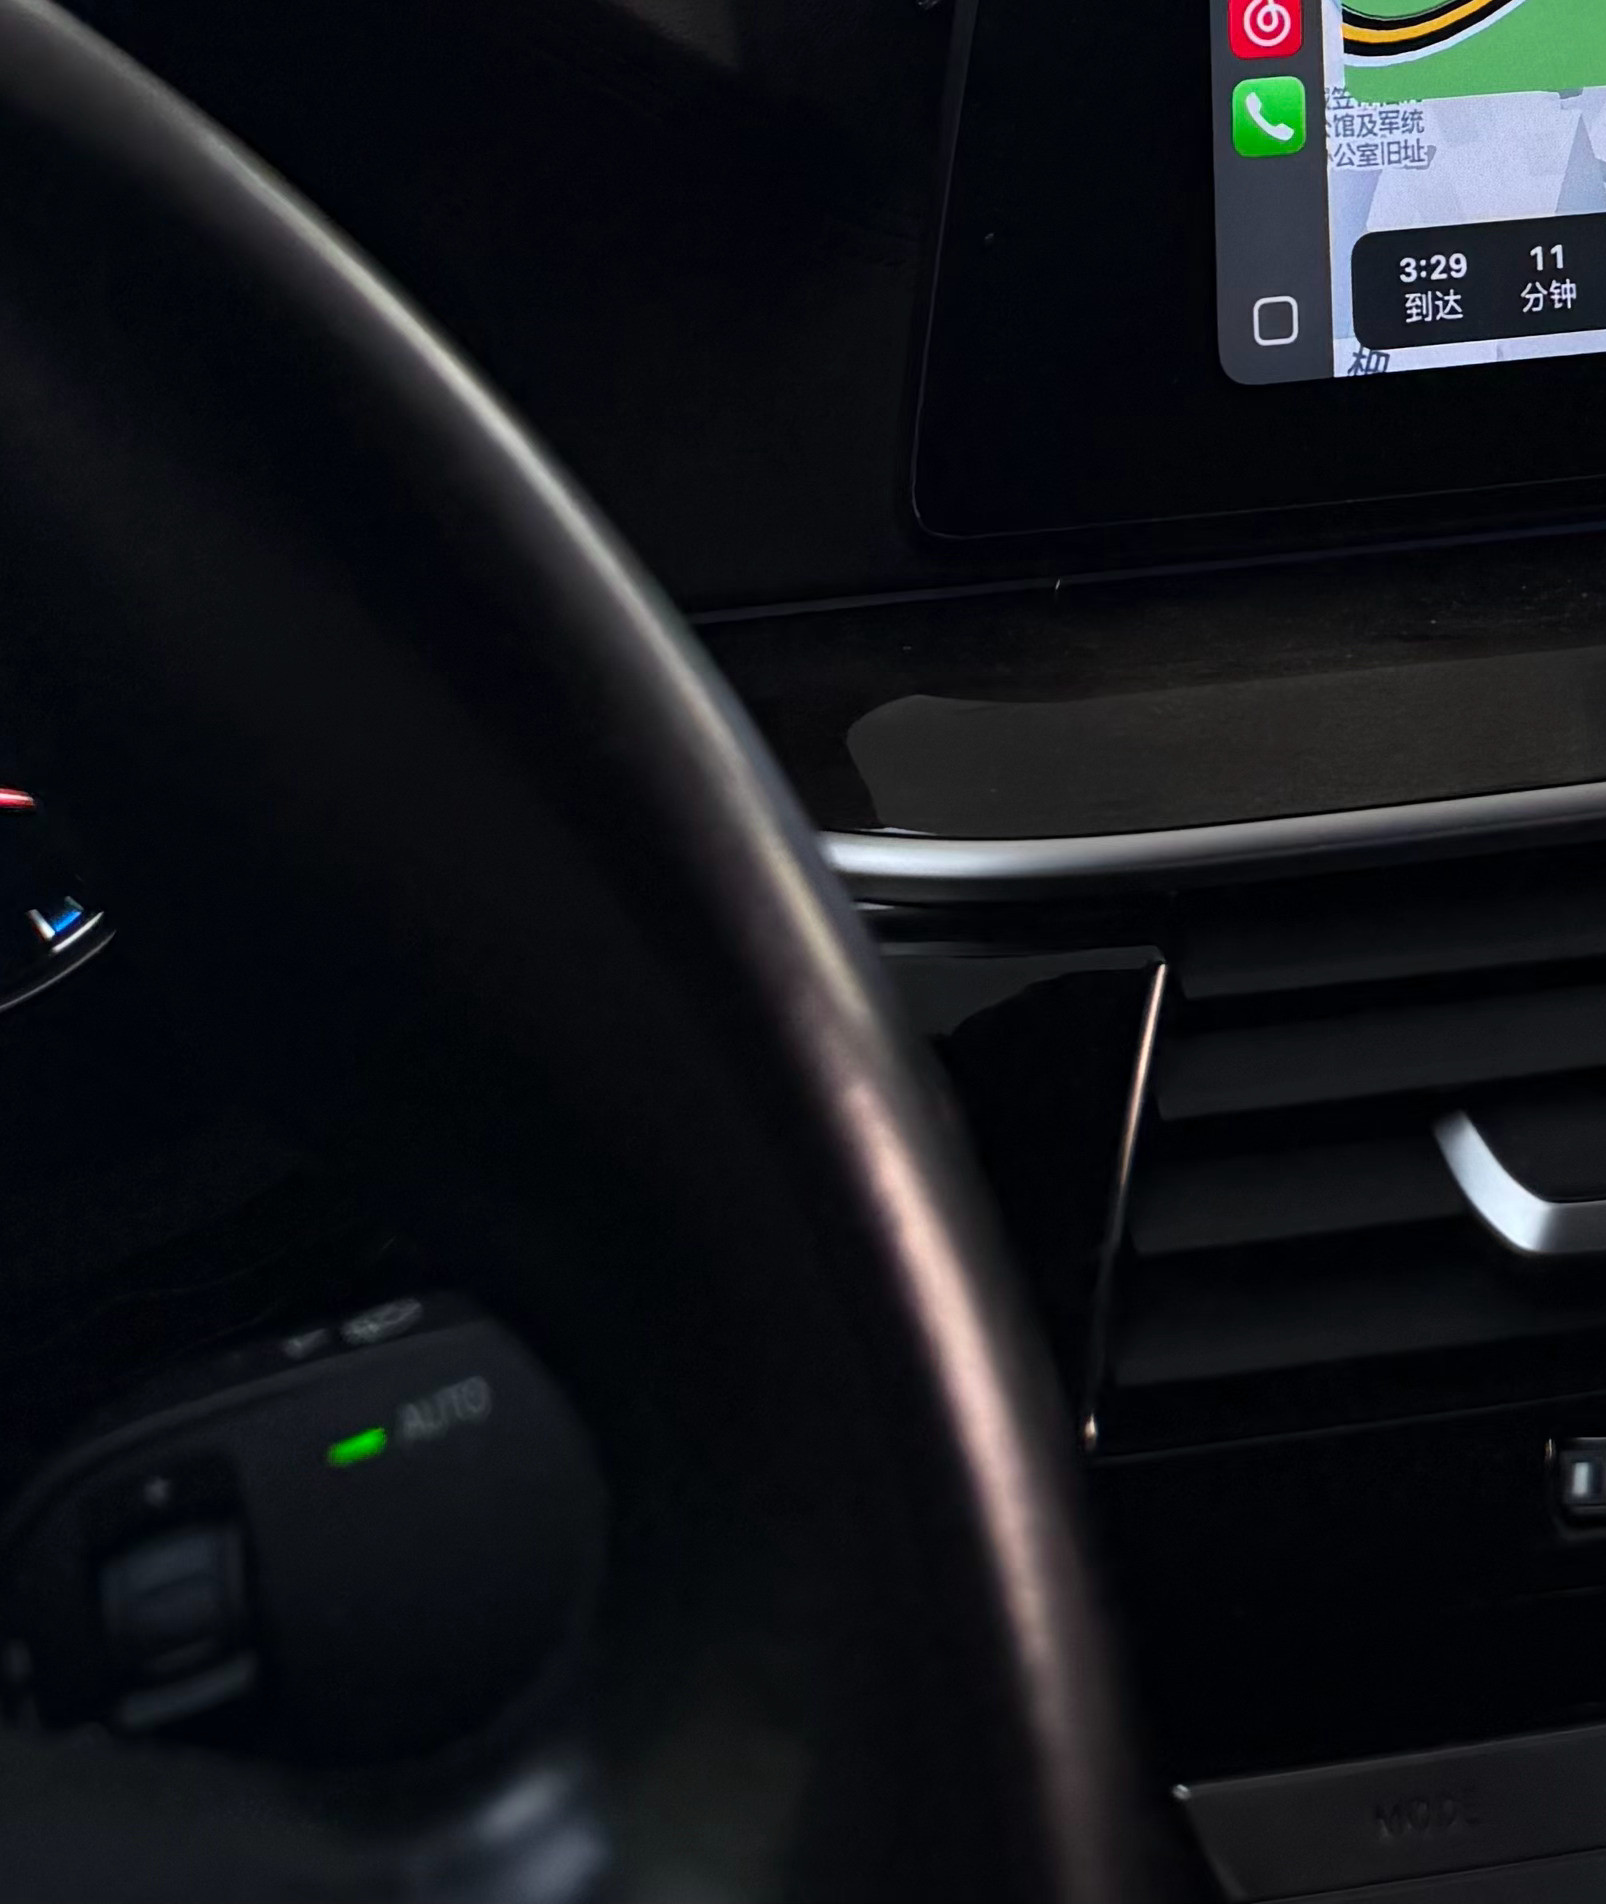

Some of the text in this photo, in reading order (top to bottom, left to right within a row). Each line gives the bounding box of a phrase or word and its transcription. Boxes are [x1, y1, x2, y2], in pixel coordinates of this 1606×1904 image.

[1326, 108, 1425, 139] 馆及军统
[1328, 137, 1426, 168] 公室旧址
[1399, 253, 1468, 283] 3:29
[1529, 244, 1566, 271] 11
[1404, 291, 1464, 324] 到达
[1519, 281, 1578, 313] 分钟
